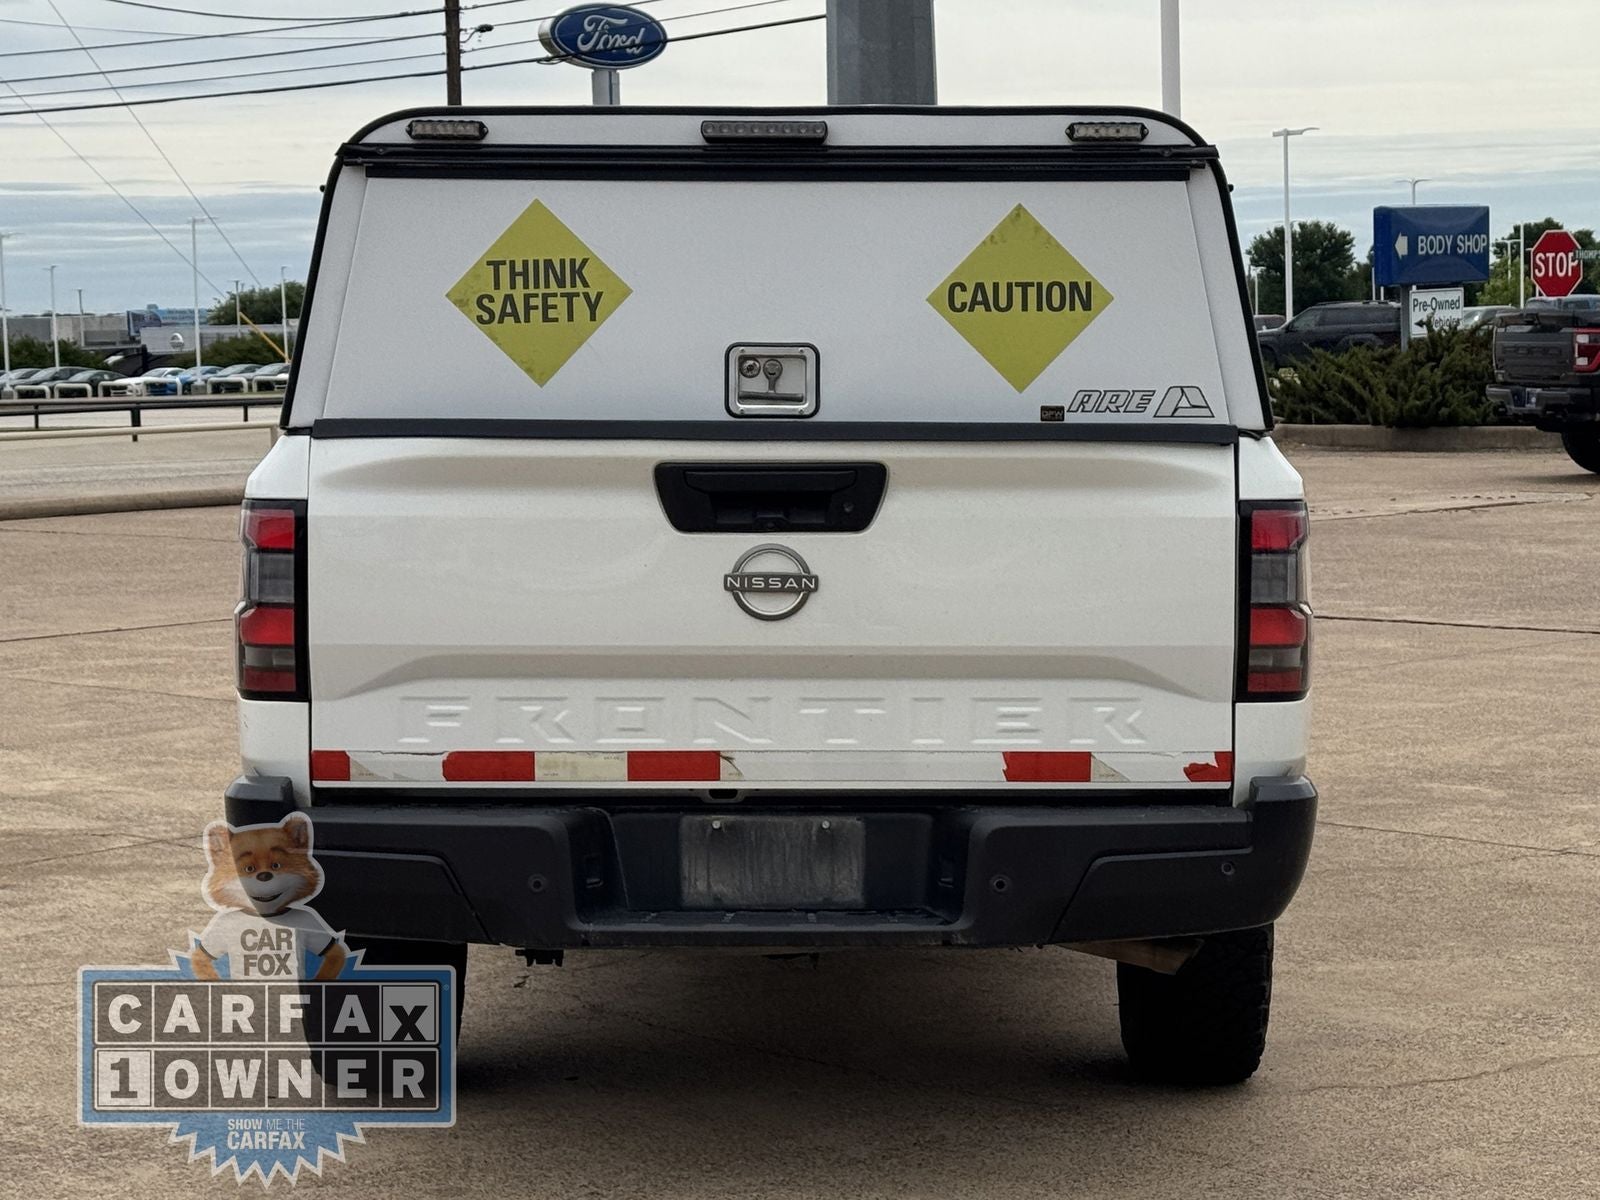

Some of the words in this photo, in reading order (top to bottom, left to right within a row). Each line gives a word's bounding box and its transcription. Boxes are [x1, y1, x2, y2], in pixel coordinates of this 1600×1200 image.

[577, 14, 646, 54] Ford
[1417, 234, 1454, 256] BODY
[1456, 233, 1488, 255] SHOP
[486, 257, 590, 290] THINK
[1534, 252, 1579, 278] STOP
[475, 291, 604, 325] SAFETY
[947, 281, 1092, 313] CAUTION
[1412, 296, 1461, 313] Pre-Owned
[1067, 389, 1157, 413] ARE
[726, 576, 816, 589] NISSAN
[399, 696, 1147, 743] FRONTIER
